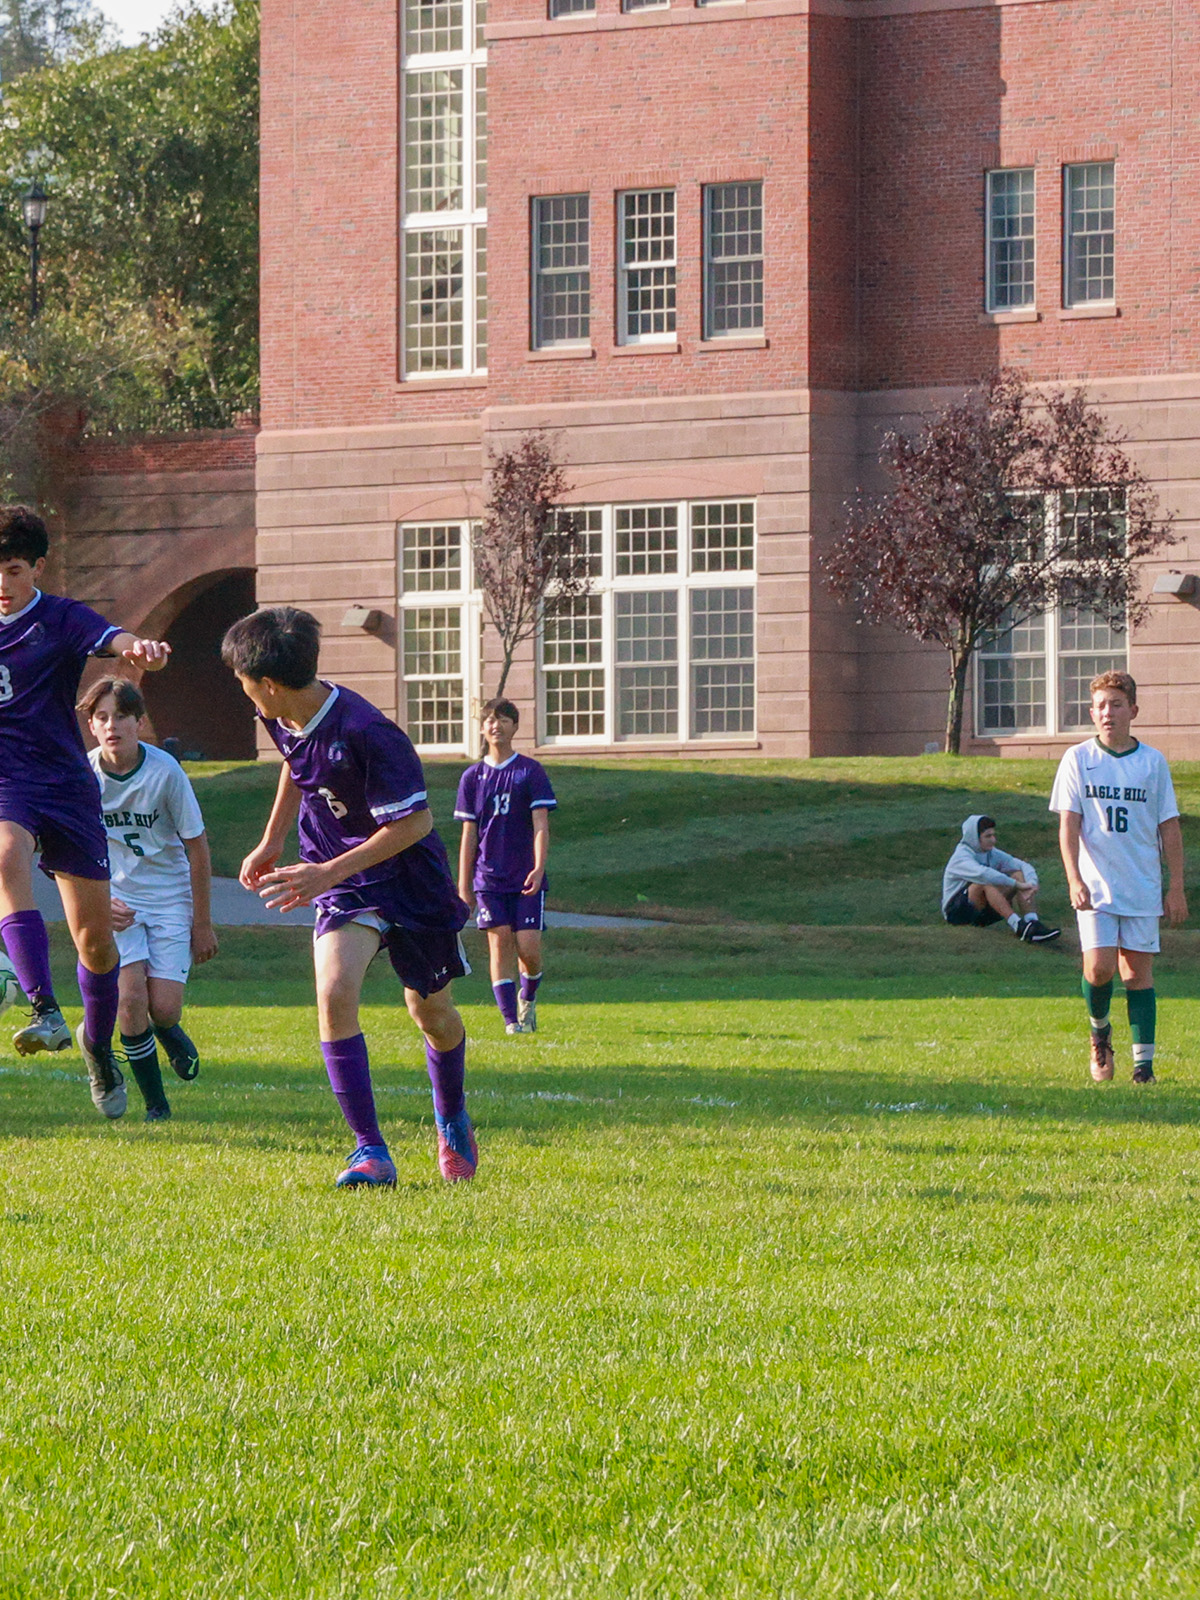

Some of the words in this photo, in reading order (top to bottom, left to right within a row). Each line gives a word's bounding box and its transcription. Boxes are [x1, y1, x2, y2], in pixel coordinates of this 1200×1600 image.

[493, 793, 511, 816] 13
[1085, 785, 1121, 800] EAGLE
[1123, 787, 1148, 803] HILL
[104, 811, 133, 828] GLE
[1105, 805, 1129, 833] 16
[123, 832, 145, 857] 5
